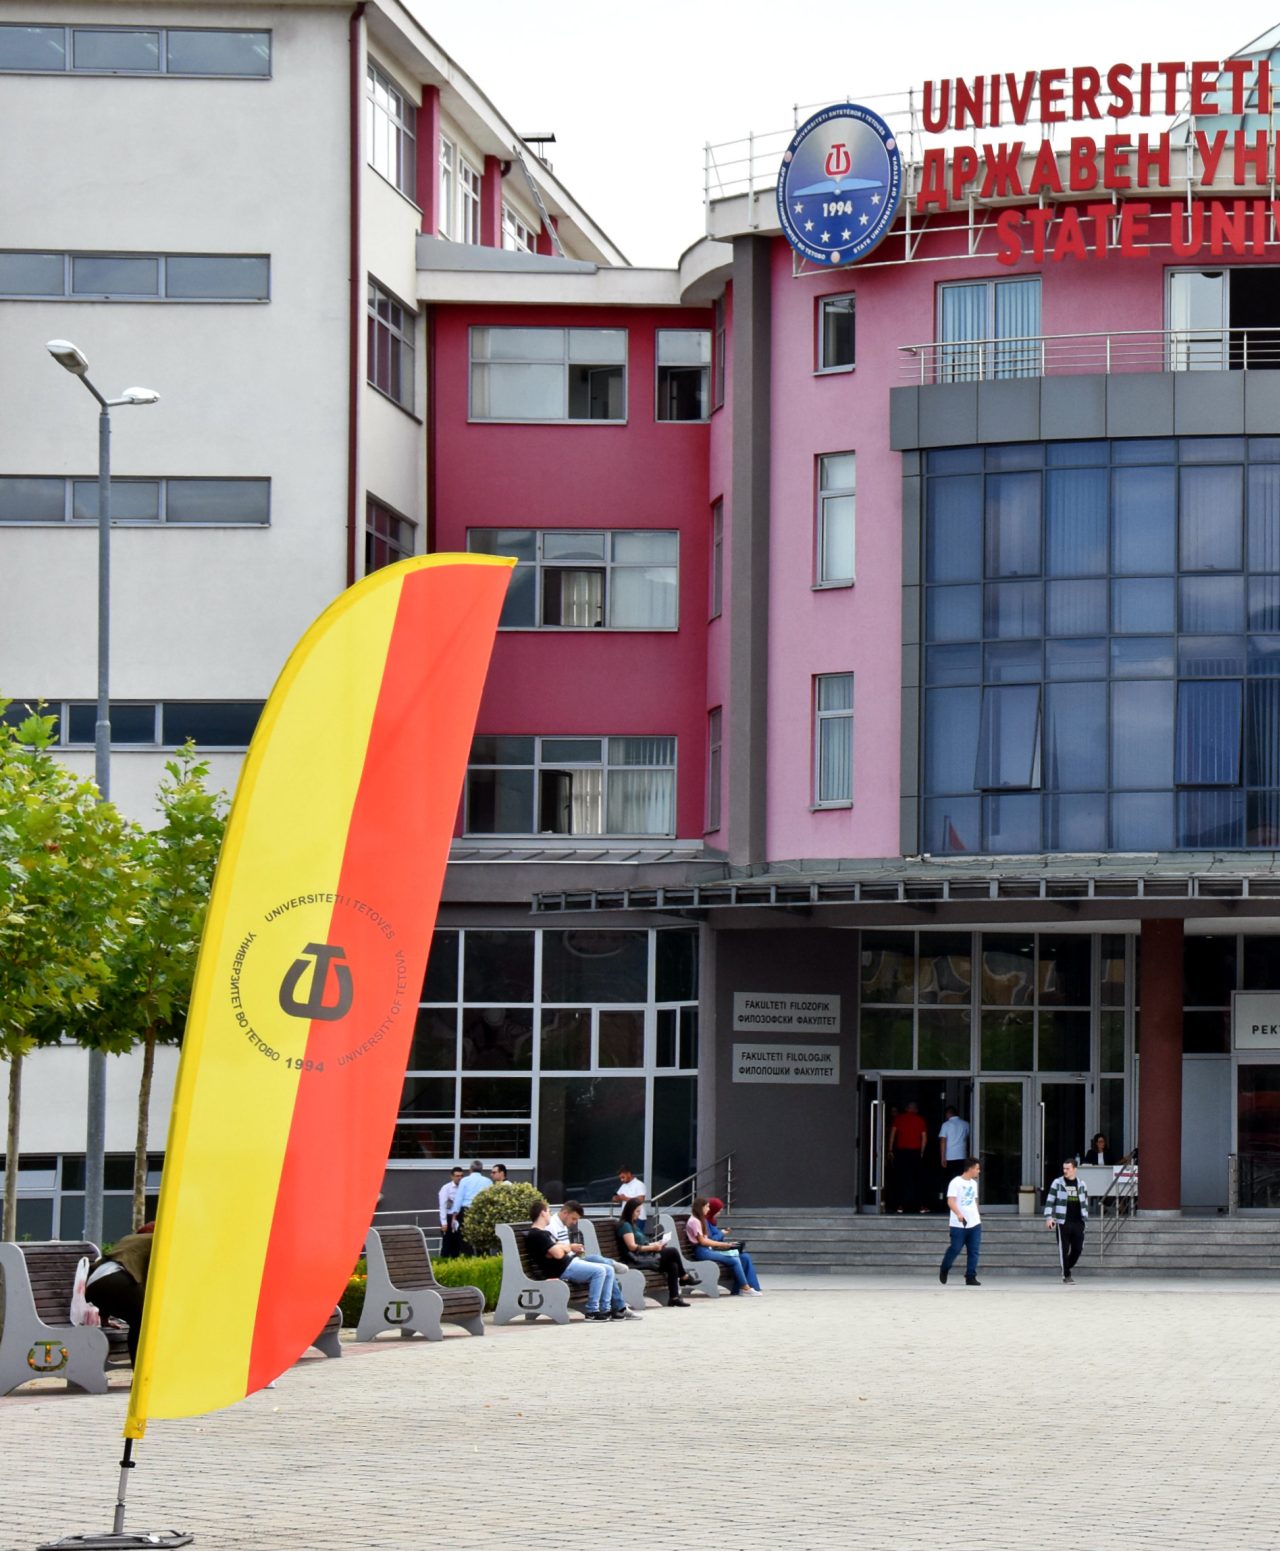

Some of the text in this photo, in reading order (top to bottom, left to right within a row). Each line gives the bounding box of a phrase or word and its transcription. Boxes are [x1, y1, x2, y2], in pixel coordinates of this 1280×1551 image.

[922, 60, 1270, 133] UNIVERSITETI
[917, 131, 1171, 212] ДРЖАВЕН
[822, 200, 853, 217] 1994
[996, 203, 1152, 267] STATE
[264, 893, 344, 922] UNIVERSITETI
[230, 932, 281, 1062] УНИВЕРЗИТЕТ ВО ТЕТОВО
[337, 950, 407, 1066] UNIVERSITY OF TETOVA
[745, 1000, 830, 1011] FAKULTETI FILOZOFIK
[737, 1014, 837, 1026] ФИЛОЗОФСКИ ФАКУЛТЕТ
[285, 1057, 324, 1073] 1994
[741, 1051, 831, 1063] FAKULTETI FILOLOGJIK
[794, 1066, 833, 1077] ФАКУЛТЕТ
